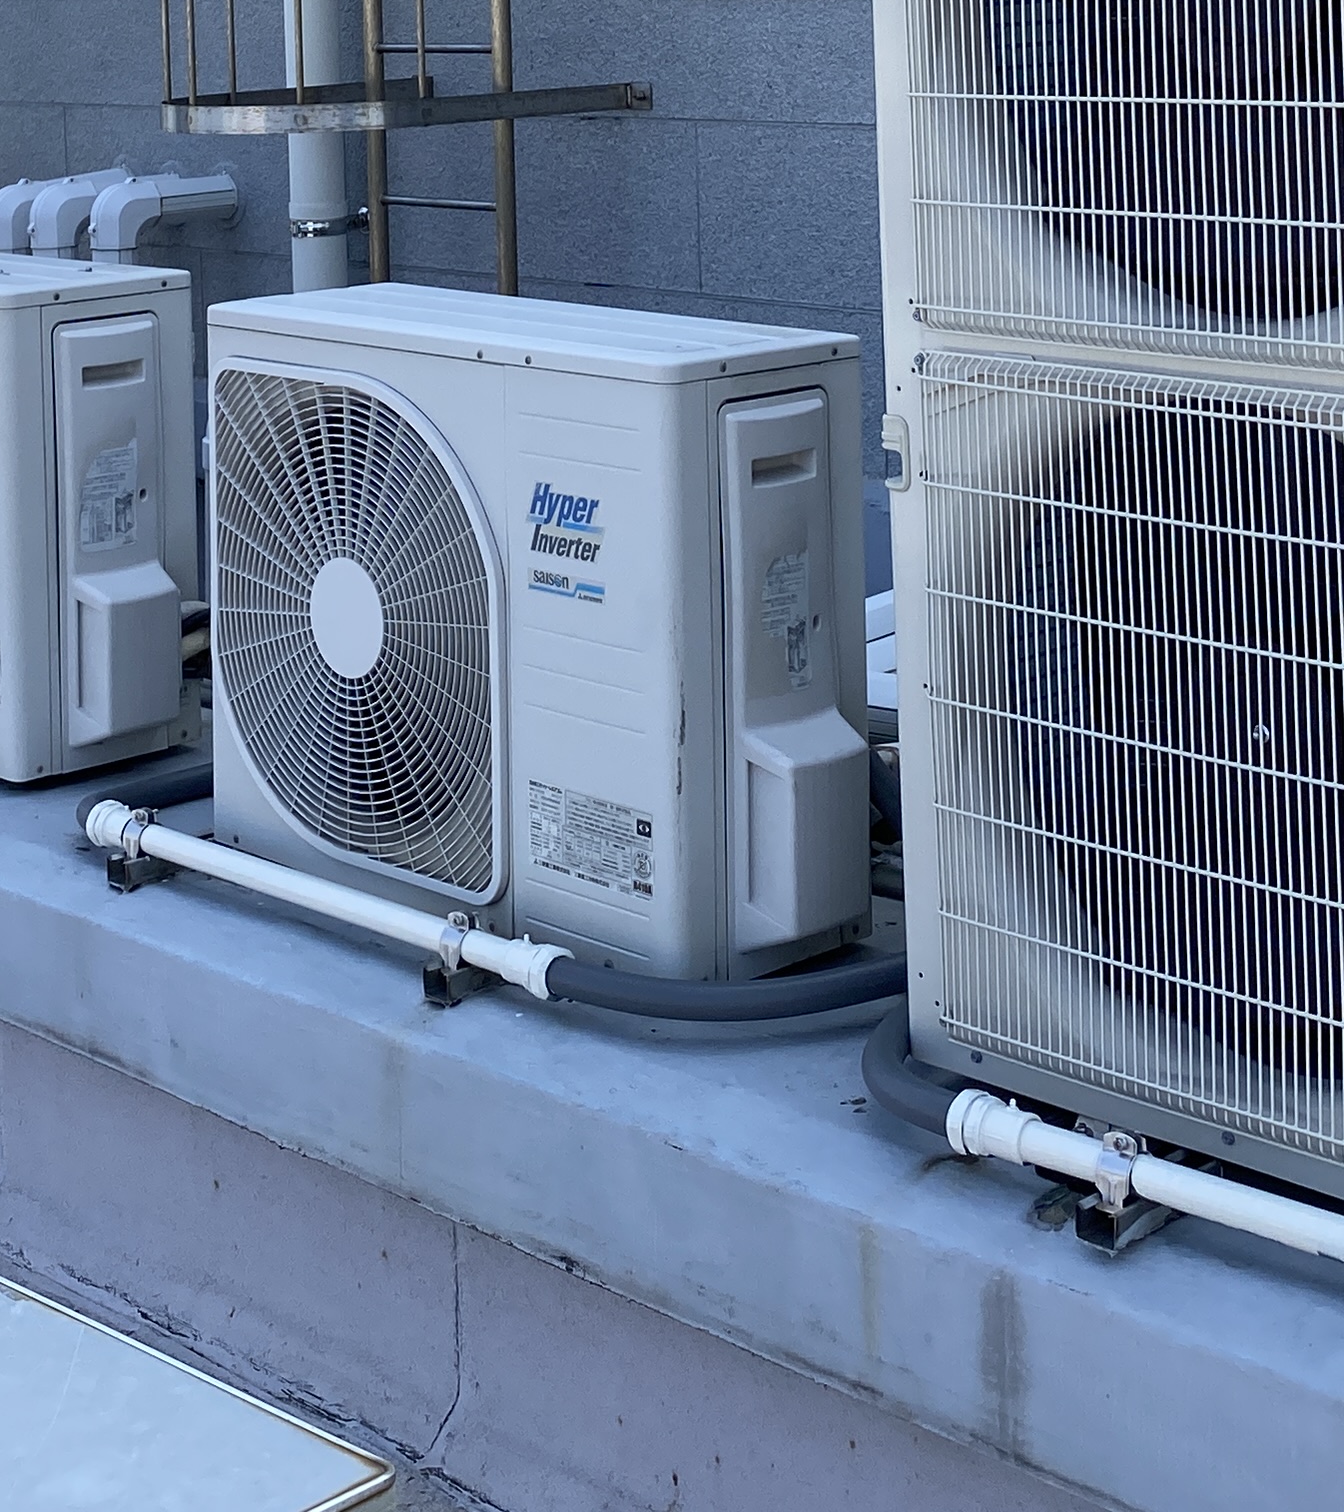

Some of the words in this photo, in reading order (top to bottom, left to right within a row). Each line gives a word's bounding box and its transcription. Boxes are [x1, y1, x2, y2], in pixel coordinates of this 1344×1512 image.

[529, 482, 600, 527] Hyper
[530, 523, 601, 563] Inverter
[532, 569, 570, 590] saison
